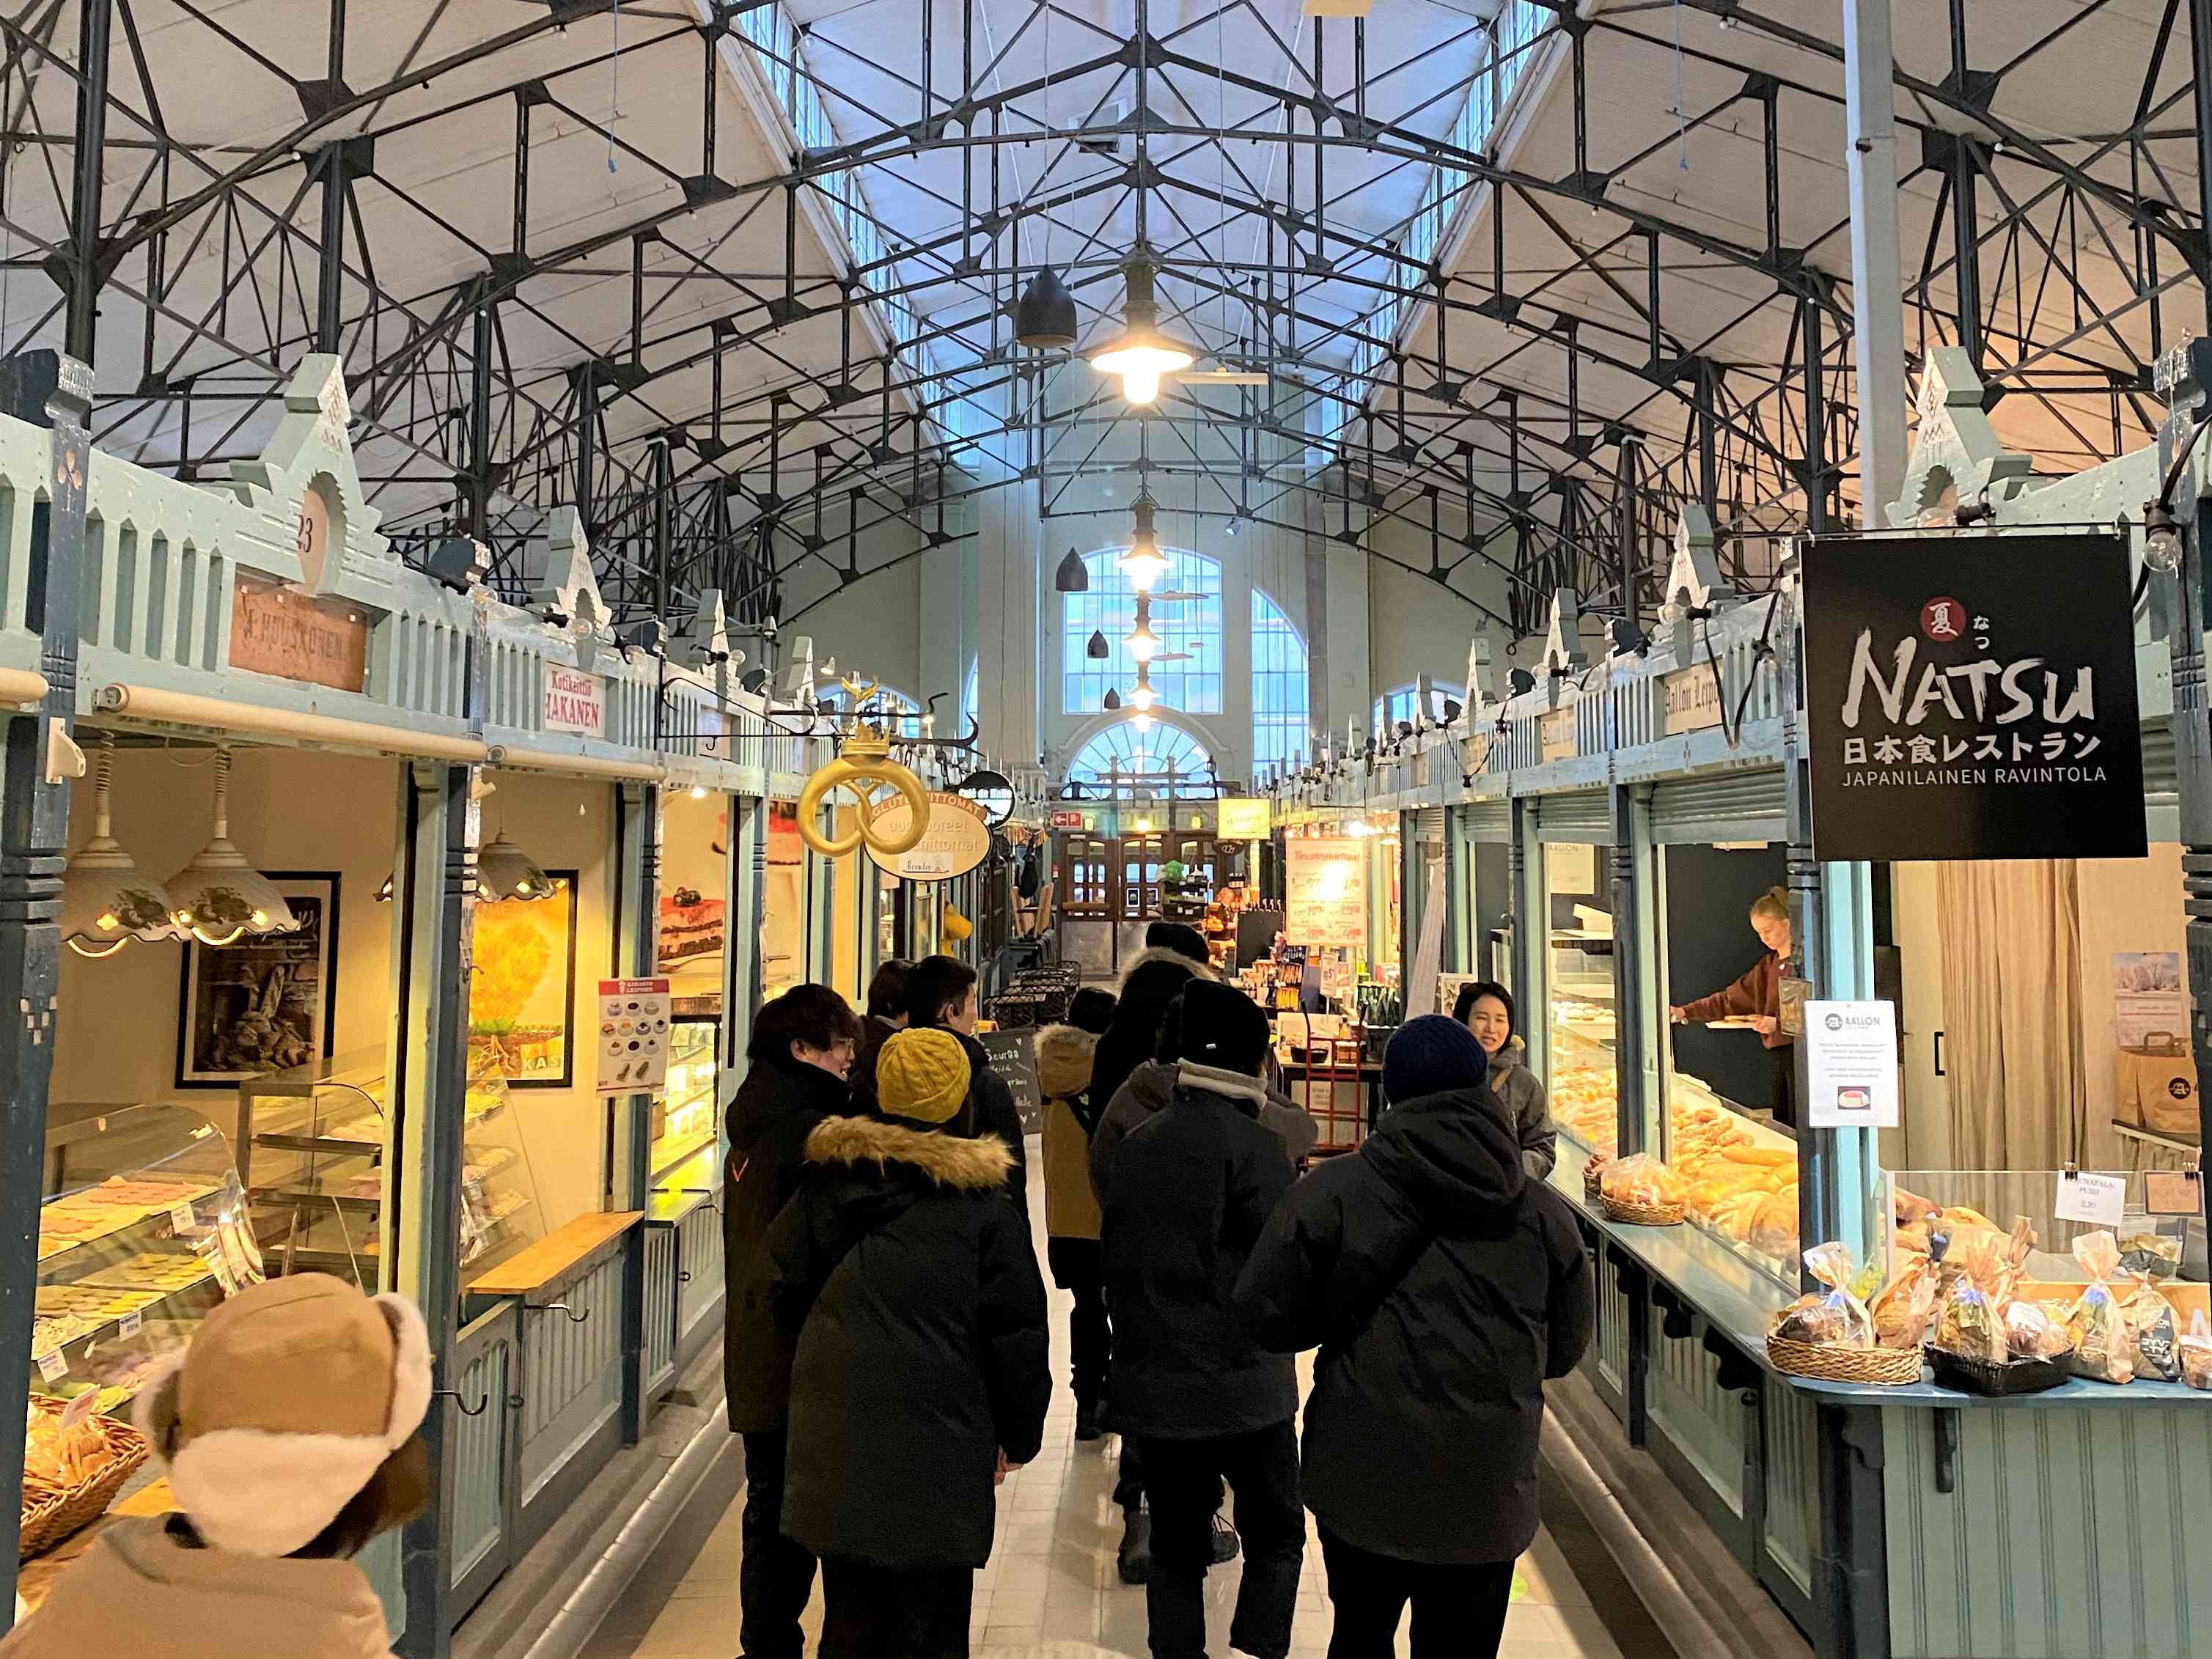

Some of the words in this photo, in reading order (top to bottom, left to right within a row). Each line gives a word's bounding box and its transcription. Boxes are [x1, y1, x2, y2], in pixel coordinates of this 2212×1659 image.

[1929, 602, 1958, 636] 夏
[1973, 615, 1990, 650] なつ
[551, 670, 592, 696] Kotikeittiö
[1842, 627, 2095, 728] NATSU
[1843, 732, 2101, 765] 日本食レストラン
[1842, 768, 1986, 787] JAPANILAINEN
[1995, 766, 2106, 784] RAVINTOLA
[1845, 1016, 1880, 1026] AALLON
